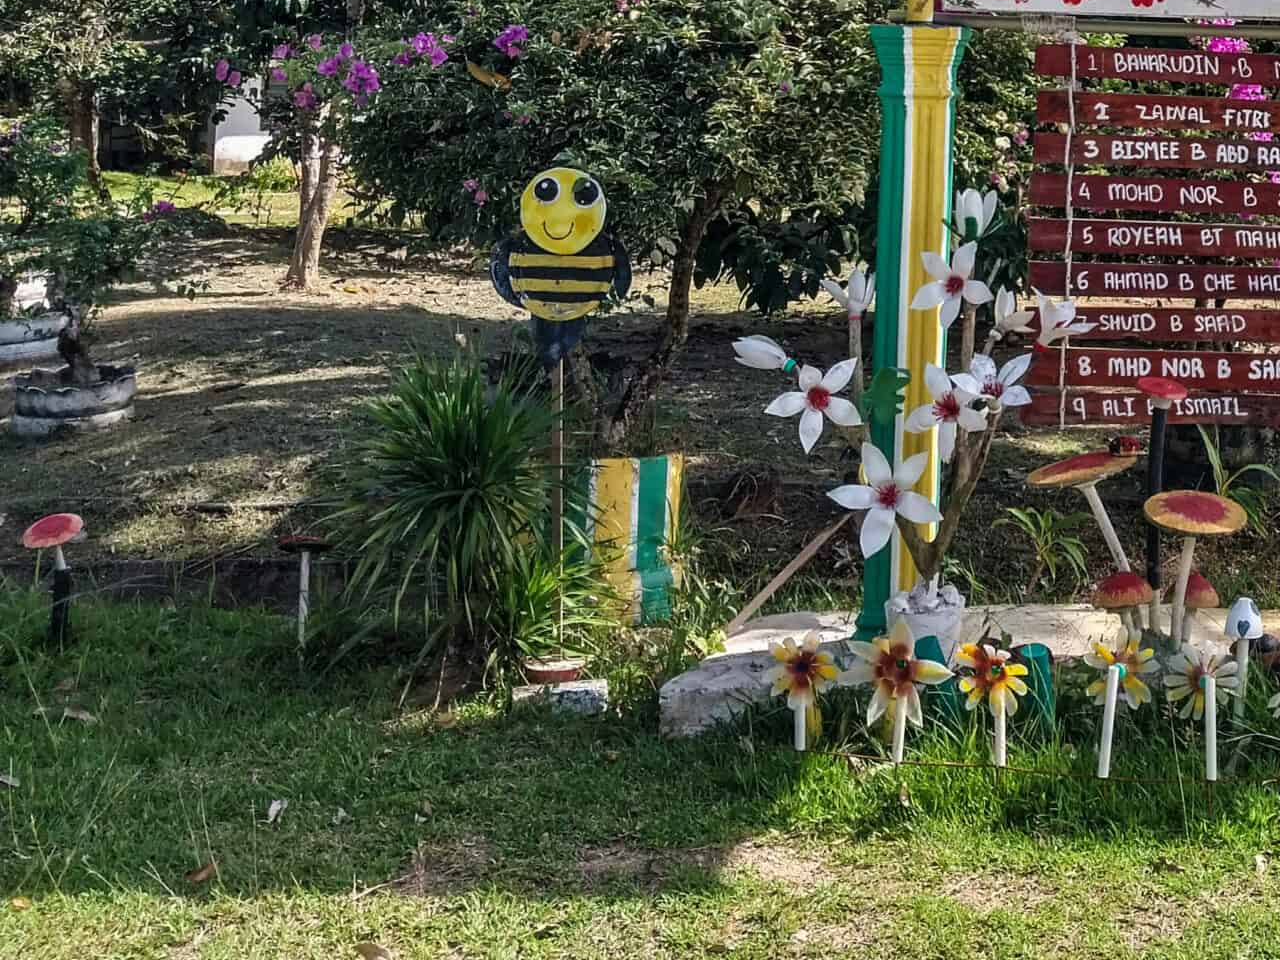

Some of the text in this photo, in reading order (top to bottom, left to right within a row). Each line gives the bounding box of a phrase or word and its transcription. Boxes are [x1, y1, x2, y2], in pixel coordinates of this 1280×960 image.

[1088, 54, 1098, 71] 1
[1114, 52, 1219, 75] BAHARUDIN
[1084, 140, 1099, 158] 3
[1111, 141, 1180, 161] BISMEE
[1216, 144, 1249, 164] ABD
[1078, 182, 1090, 200] 4
[1108, 183, 1163, 202] MOHD
[1180, 186, 1224, 206] NOR
[1243, 187, 1257, 207] B
[1083, 226, 1094, 245] 5
[1108, 226, 1183, 246] ROYEAH
[1200, 228, 1223, 246] BT
[1076, 271, 1089, 289] 6
[1104, 271, 1168, 290] AHMAD
[1179, 273, 1194, 290] B
[1204, 274, 1237, 291] CHE
[1100, 313, 1156, 332] SHUID
[1170, 315, 1183, 332] B
[1195, 315, 1246, 333] SAAD
[1108, 357, 1151, 377] MHD
[1162, 358, 1205, 378] NOR
[1217, 358, 1231, 379] B
[1072, 397, 1085, 421] 9
[1102, 397, 1136, 417] ALI
[1174, 397, 1248, 416] ISMAIL
